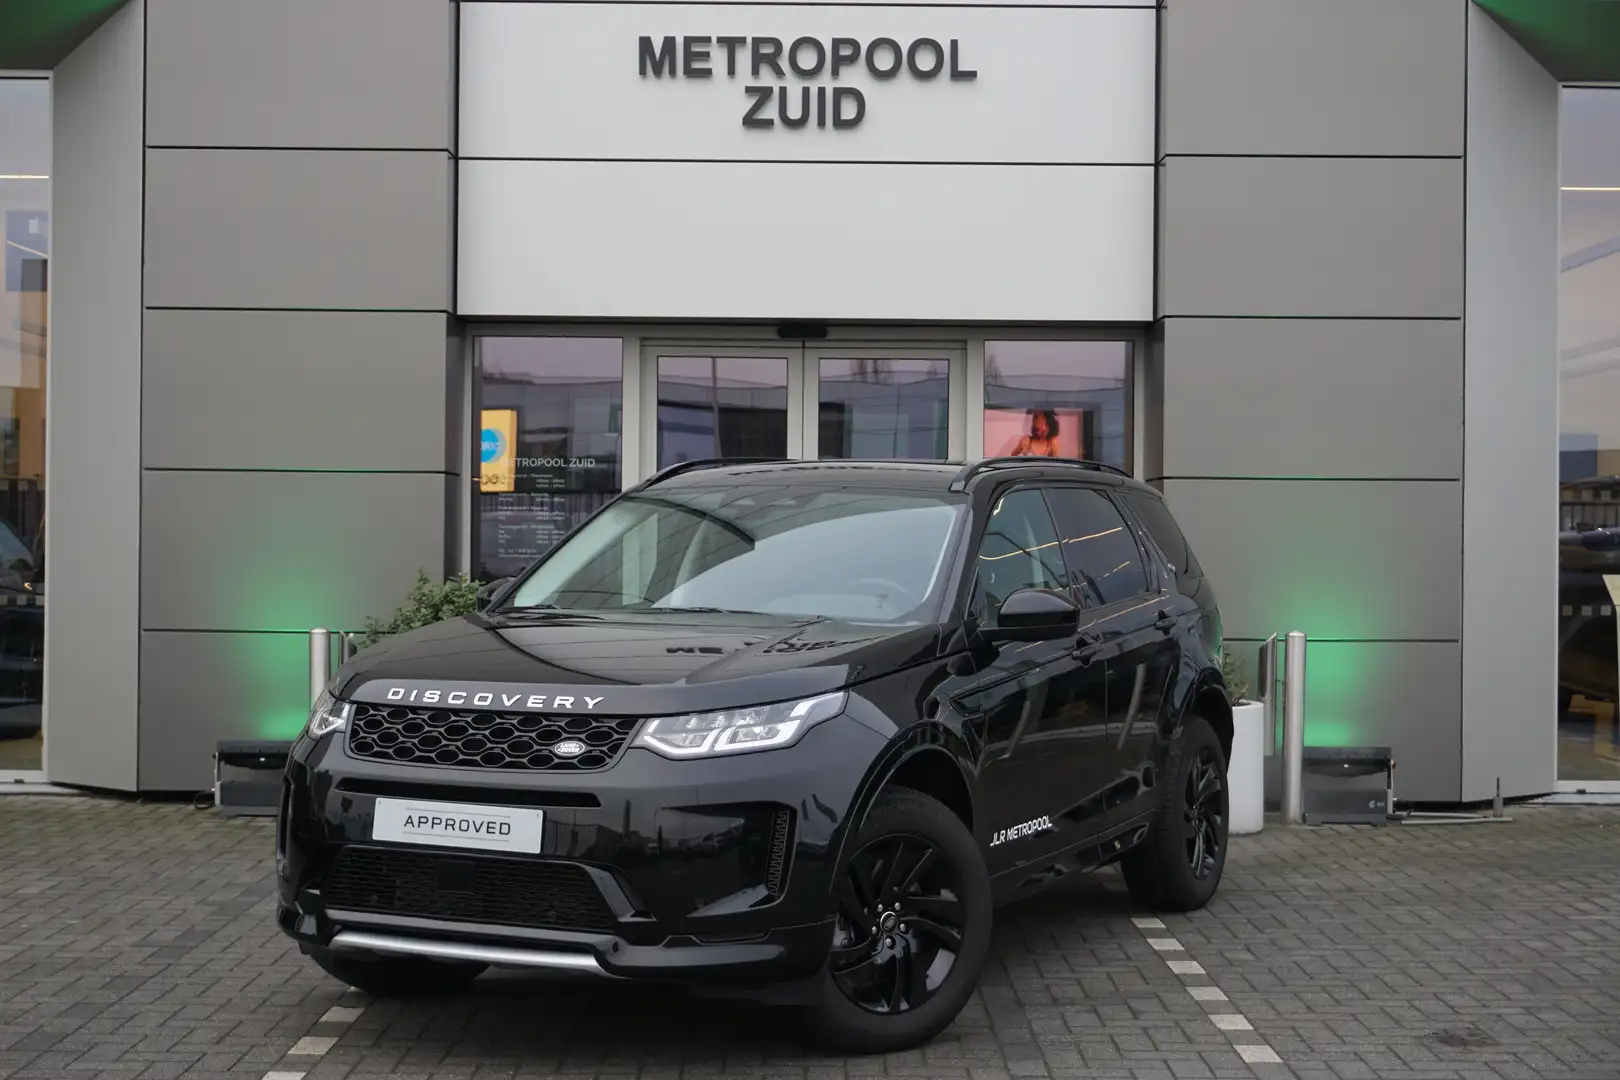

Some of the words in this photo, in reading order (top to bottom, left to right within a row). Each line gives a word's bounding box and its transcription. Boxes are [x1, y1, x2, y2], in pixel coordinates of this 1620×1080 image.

[638, 36, 978, 80] METROPOOL
[742, 86, 867, 128] ZUID
[499, 457, 567, 468] ETROPOOL
[569, 458, 595, 468] ZUID
[387, 687, 605, 709] DISCOVERY
[404, 815, 511, 836] APPROVED
[989, 829, 1006, 847] JLR
[1007, 815, 1053, 841] METROPOOL
